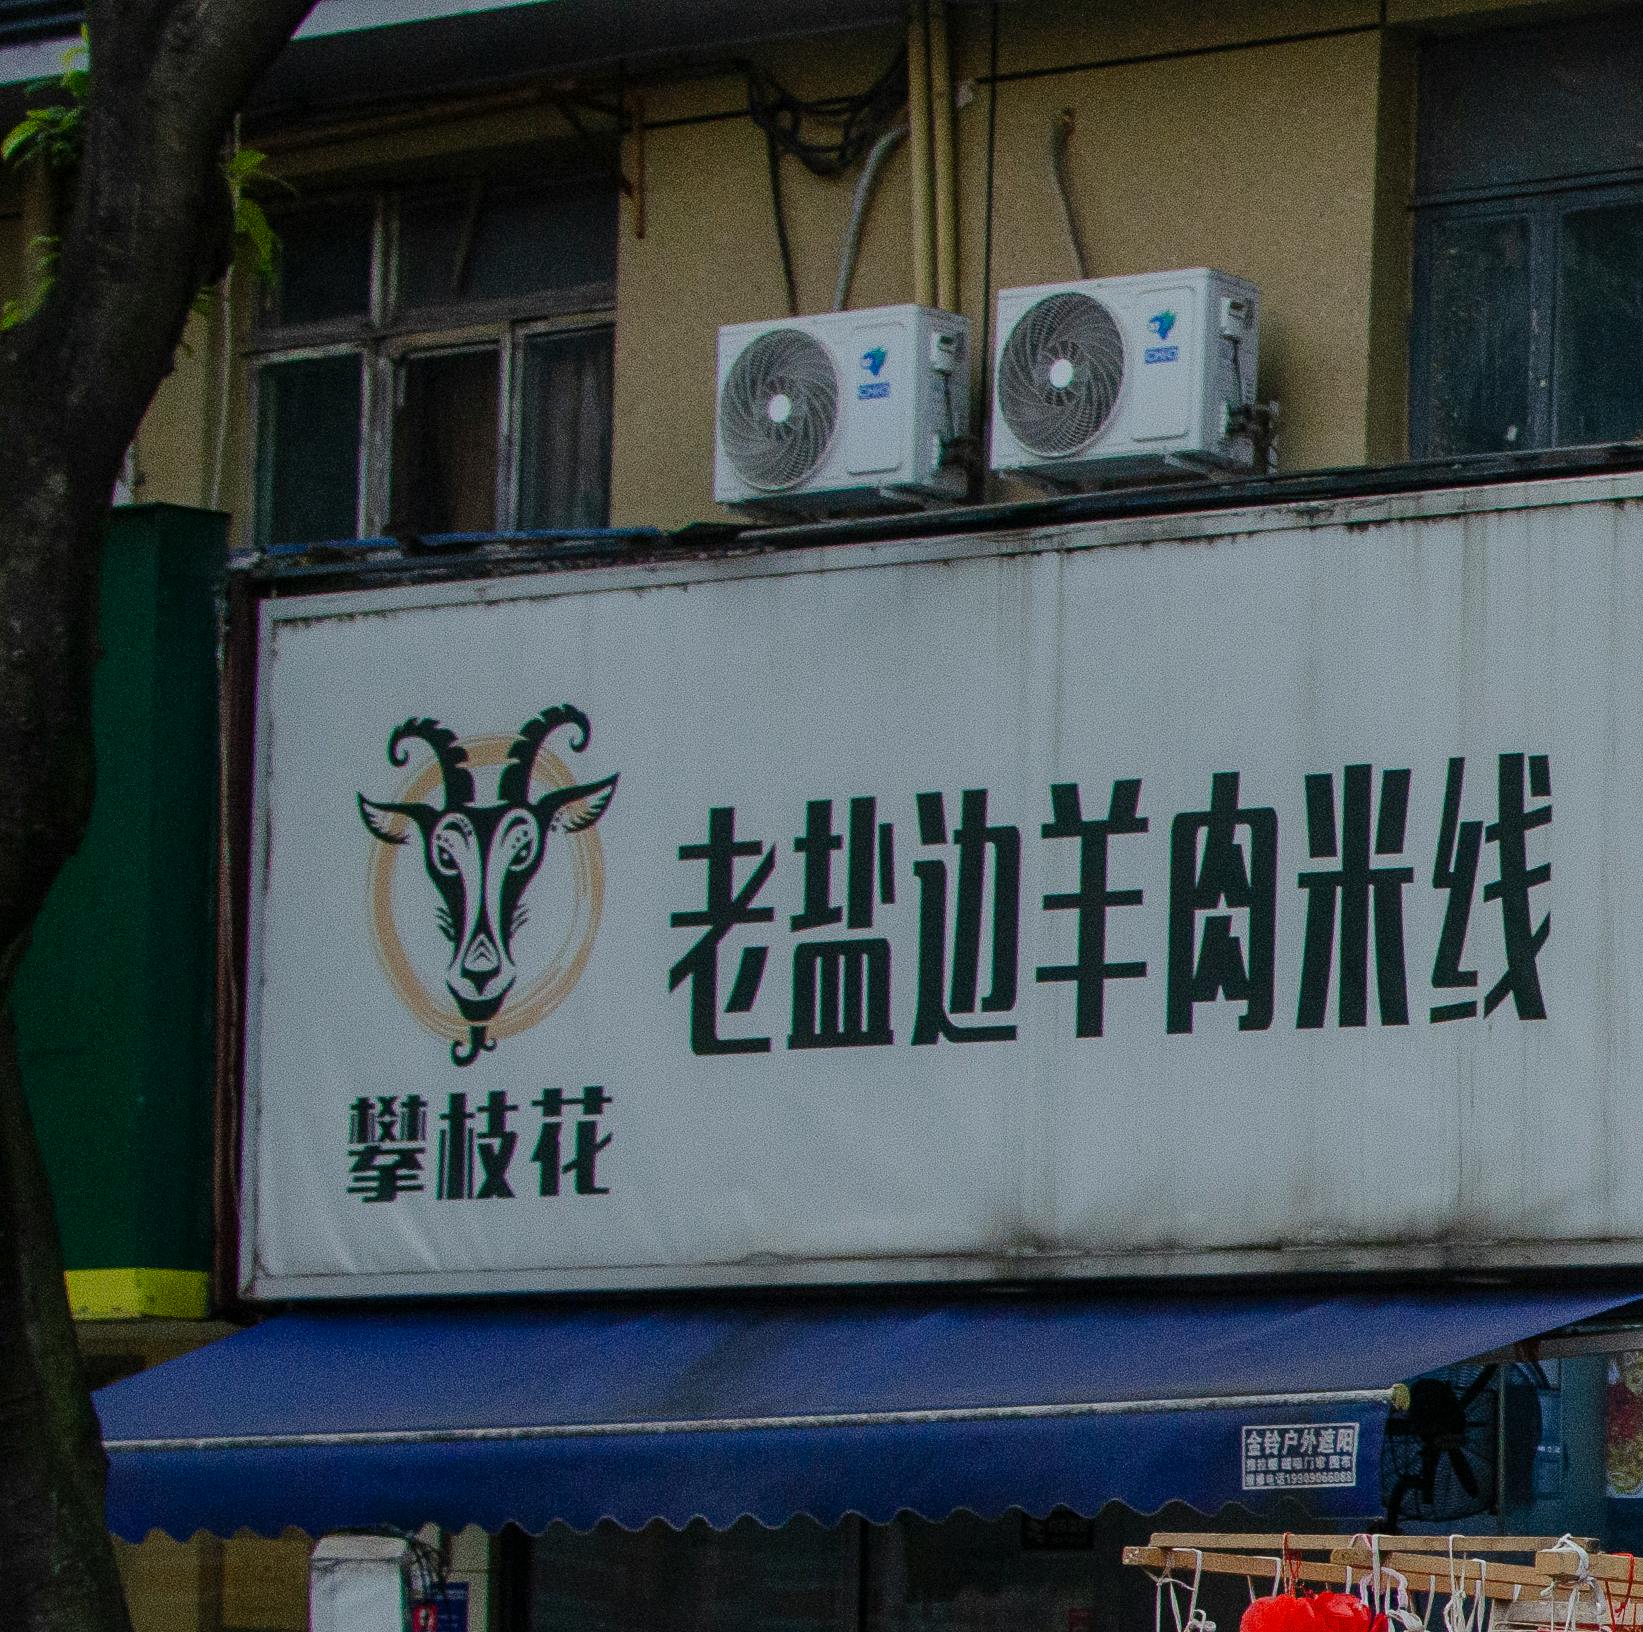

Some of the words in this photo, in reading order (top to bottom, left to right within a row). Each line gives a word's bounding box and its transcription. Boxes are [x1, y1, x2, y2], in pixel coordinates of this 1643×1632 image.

[666, 752, 1553, 1056] 老盐边羊肉米线
[345, 1086, 614, 1204] 攀枝花
